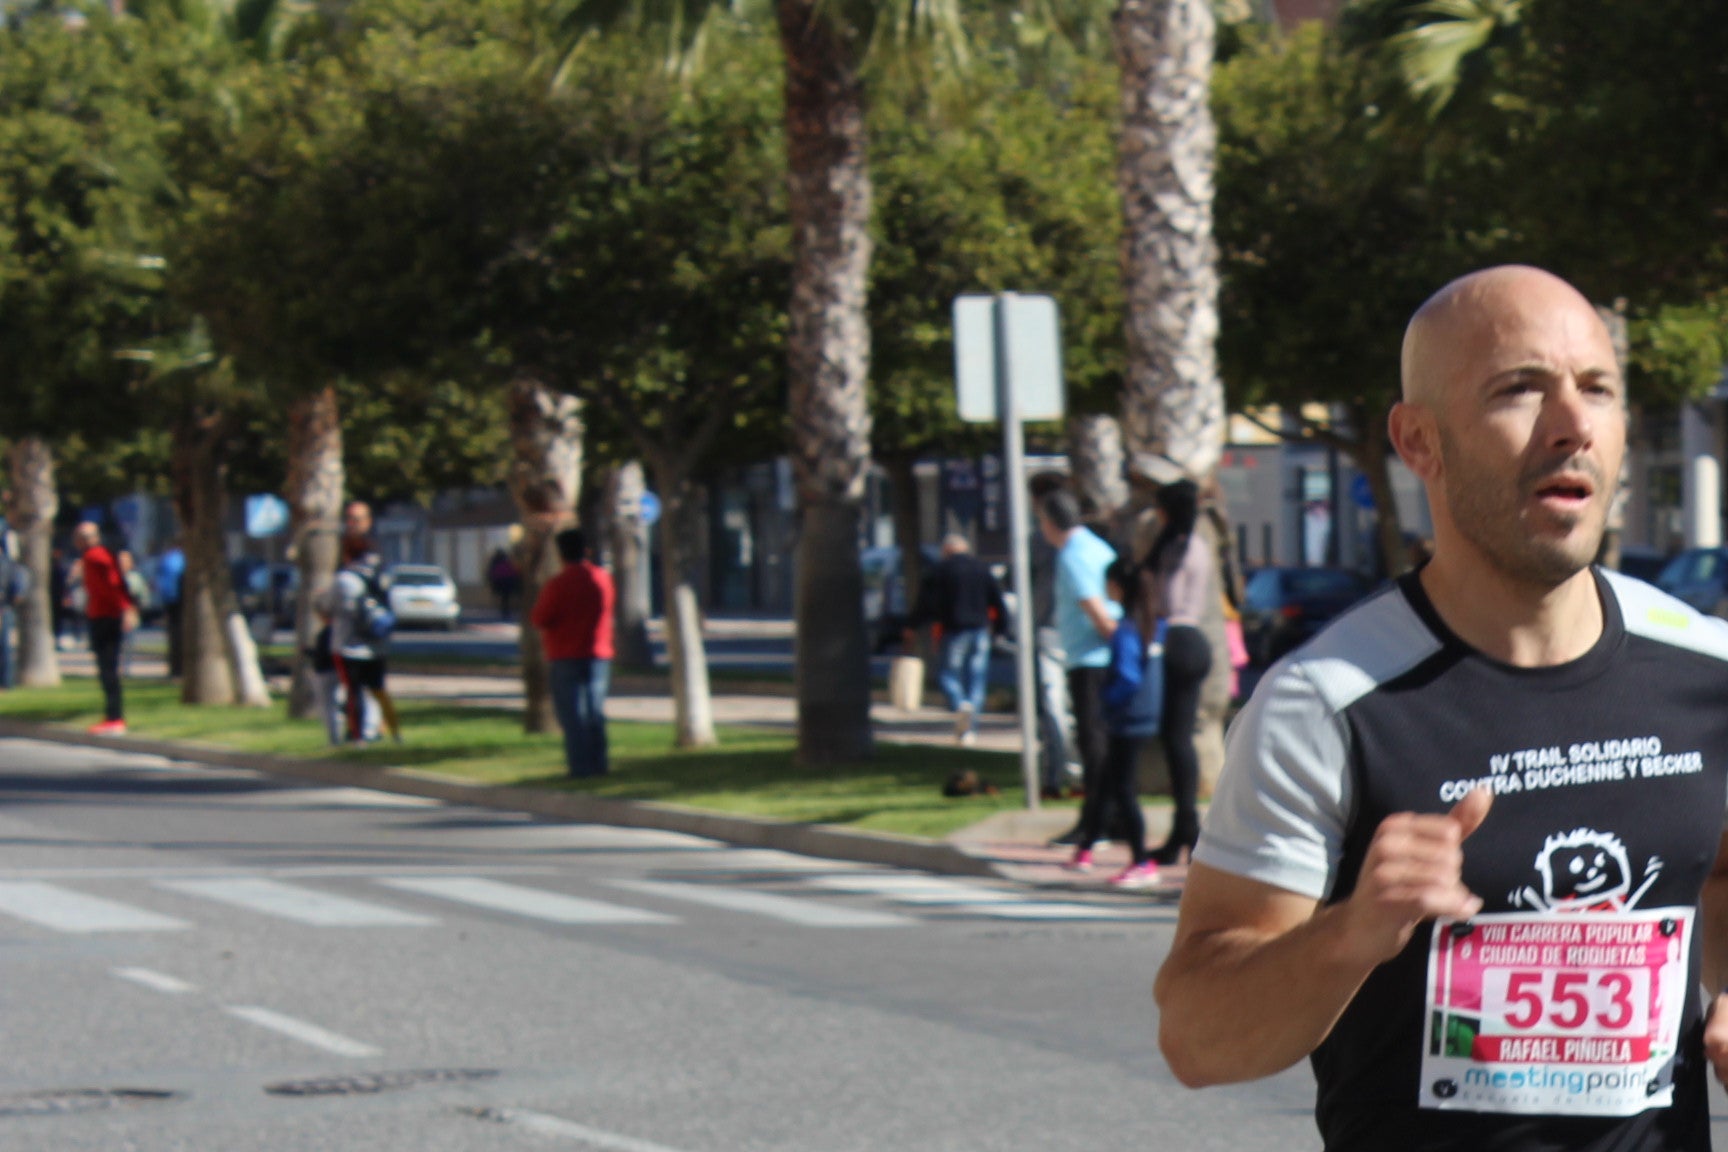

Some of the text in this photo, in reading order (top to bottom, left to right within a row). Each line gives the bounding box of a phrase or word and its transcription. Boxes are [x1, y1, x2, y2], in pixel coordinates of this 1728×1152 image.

[1490, 736, 1662, 774] IV TRAIL SOLIDARIO
[1524, 759, 1625, 790] DUCHENNE
[1625, 760, 1638, 778] Y
[1641, 751, 1703, 777] BECKER
[1510, 924, 1582, 943] CARRERA
[1586, 923, 1652, 943] POPULAR
[1479, 945, 1646, 966] CIUDAD DE ROQUETAS
[1504, 971, 1634, 1029] 553
[1500, 1038, 1631, 1062] RAFAEL PIÑUELA
